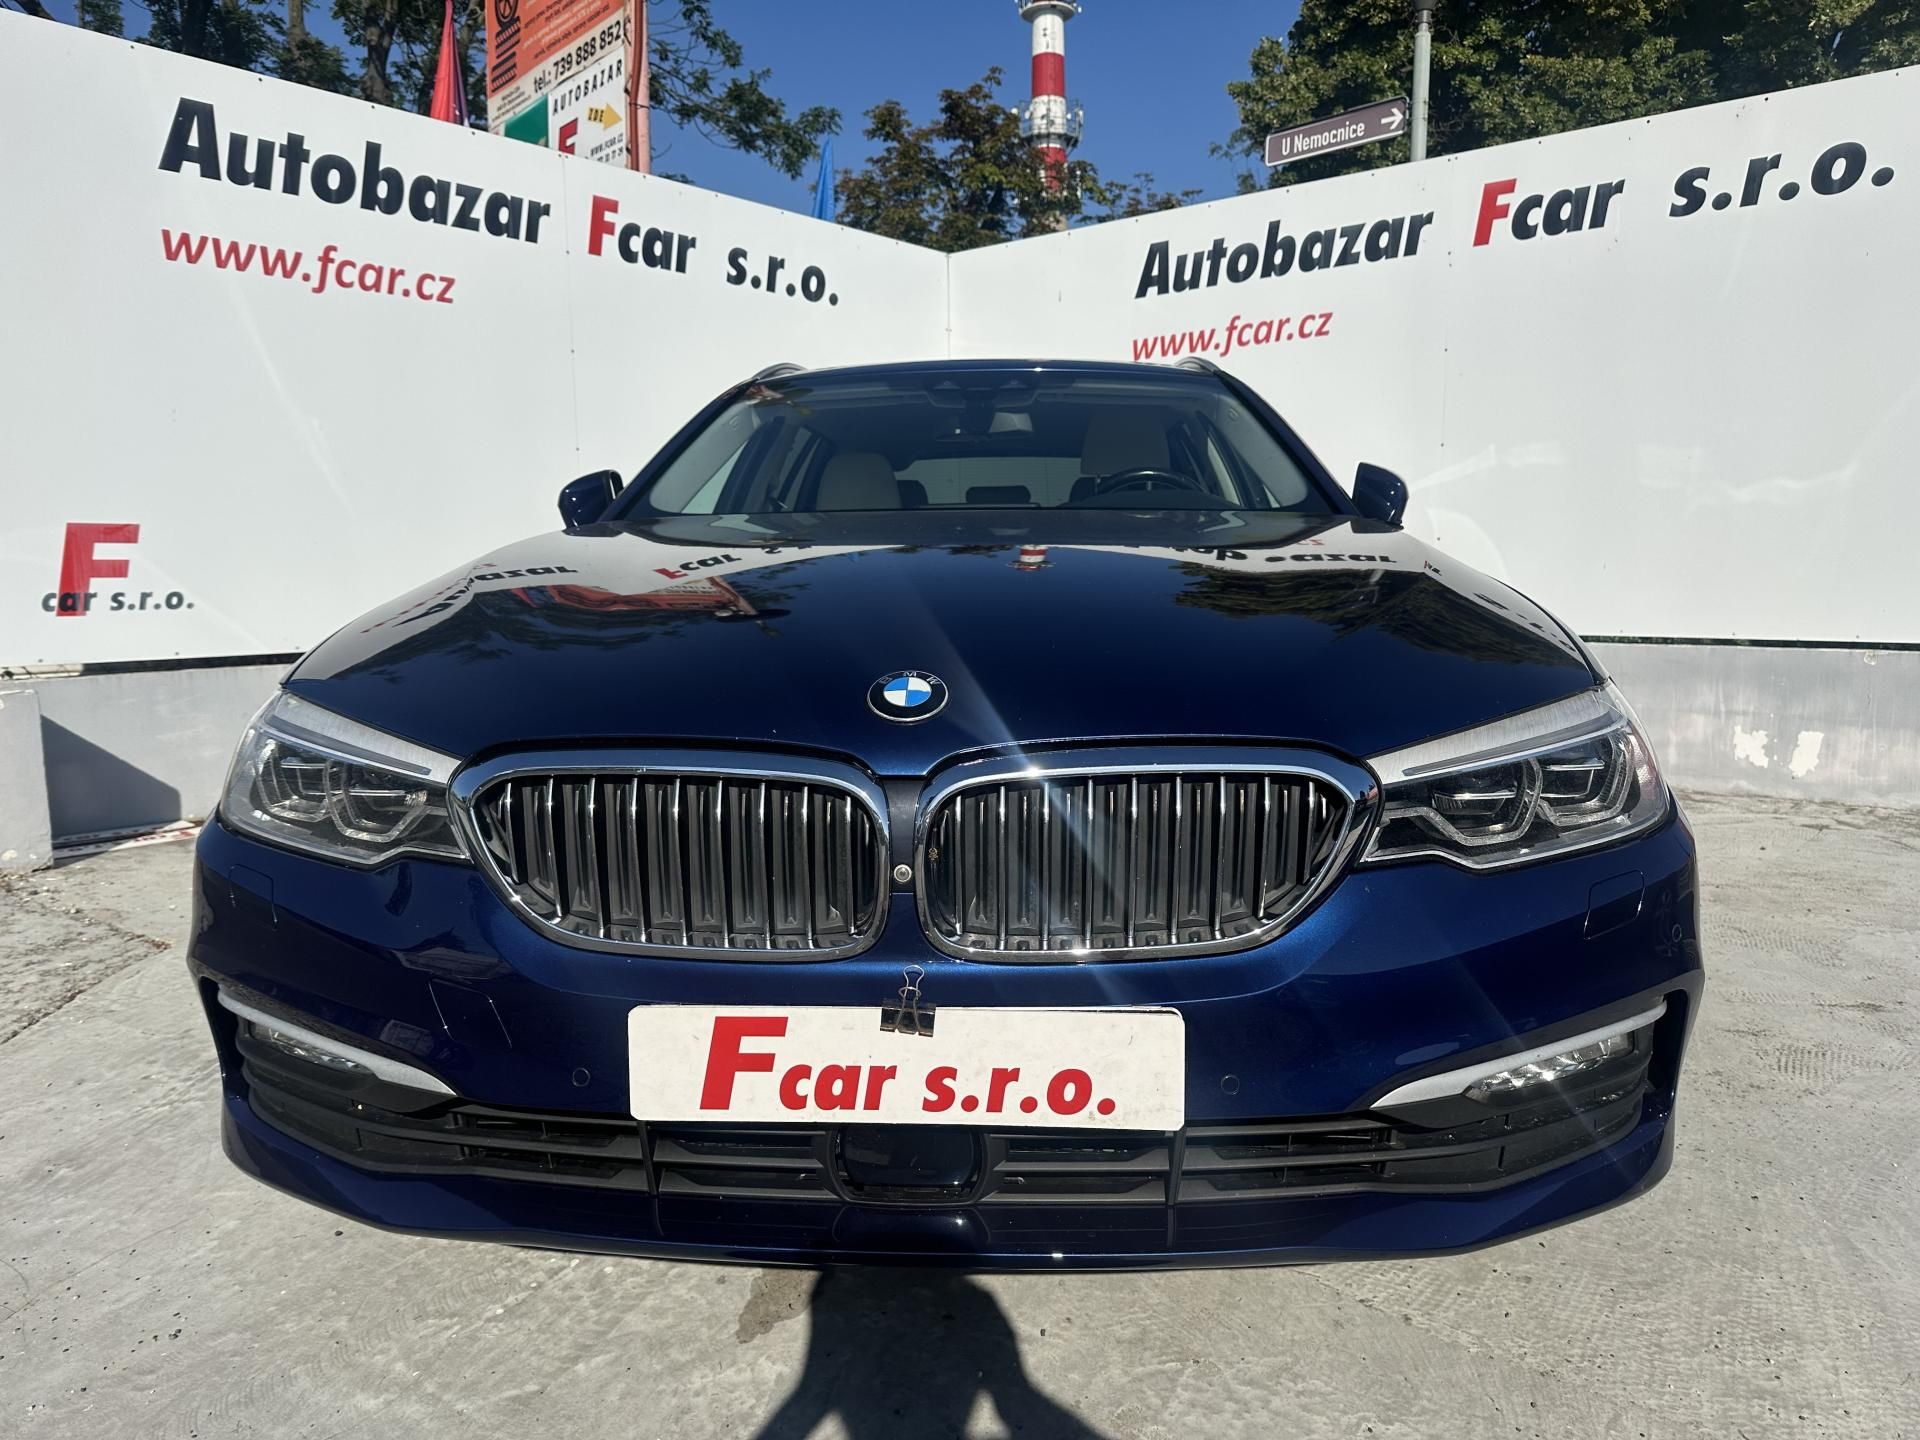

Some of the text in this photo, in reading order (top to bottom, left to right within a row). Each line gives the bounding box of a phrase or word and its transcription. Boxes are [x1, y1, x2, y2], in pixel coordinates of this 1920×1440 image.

[533, 69, 552, 94] tel.:
[553, 52, 573, 81] 739
[575, 36, 597, 66] 888
[599, 19, 621, 50] 852
[552, 58, 623, 117] AUTOBAZAR
[587, 107, 605, 123] ZDE
[1281, 121, 1365, 156] U Nemocnice
[158, 97, 839, 306] Autobazar Fcar s.r.o.
[1135, 141, 1895, 300] Autobazar Fcar s.r.o.
[161, 228, 456, 304] www.fcar.cz
[1132, 312, 1333, 364] www.fcar.cz
[109, 590, 195, 612] s.r.o.
[878, 669, 942, 686] BMW
[699, 1015, 1117, 1116] Fcar s.r.o.
